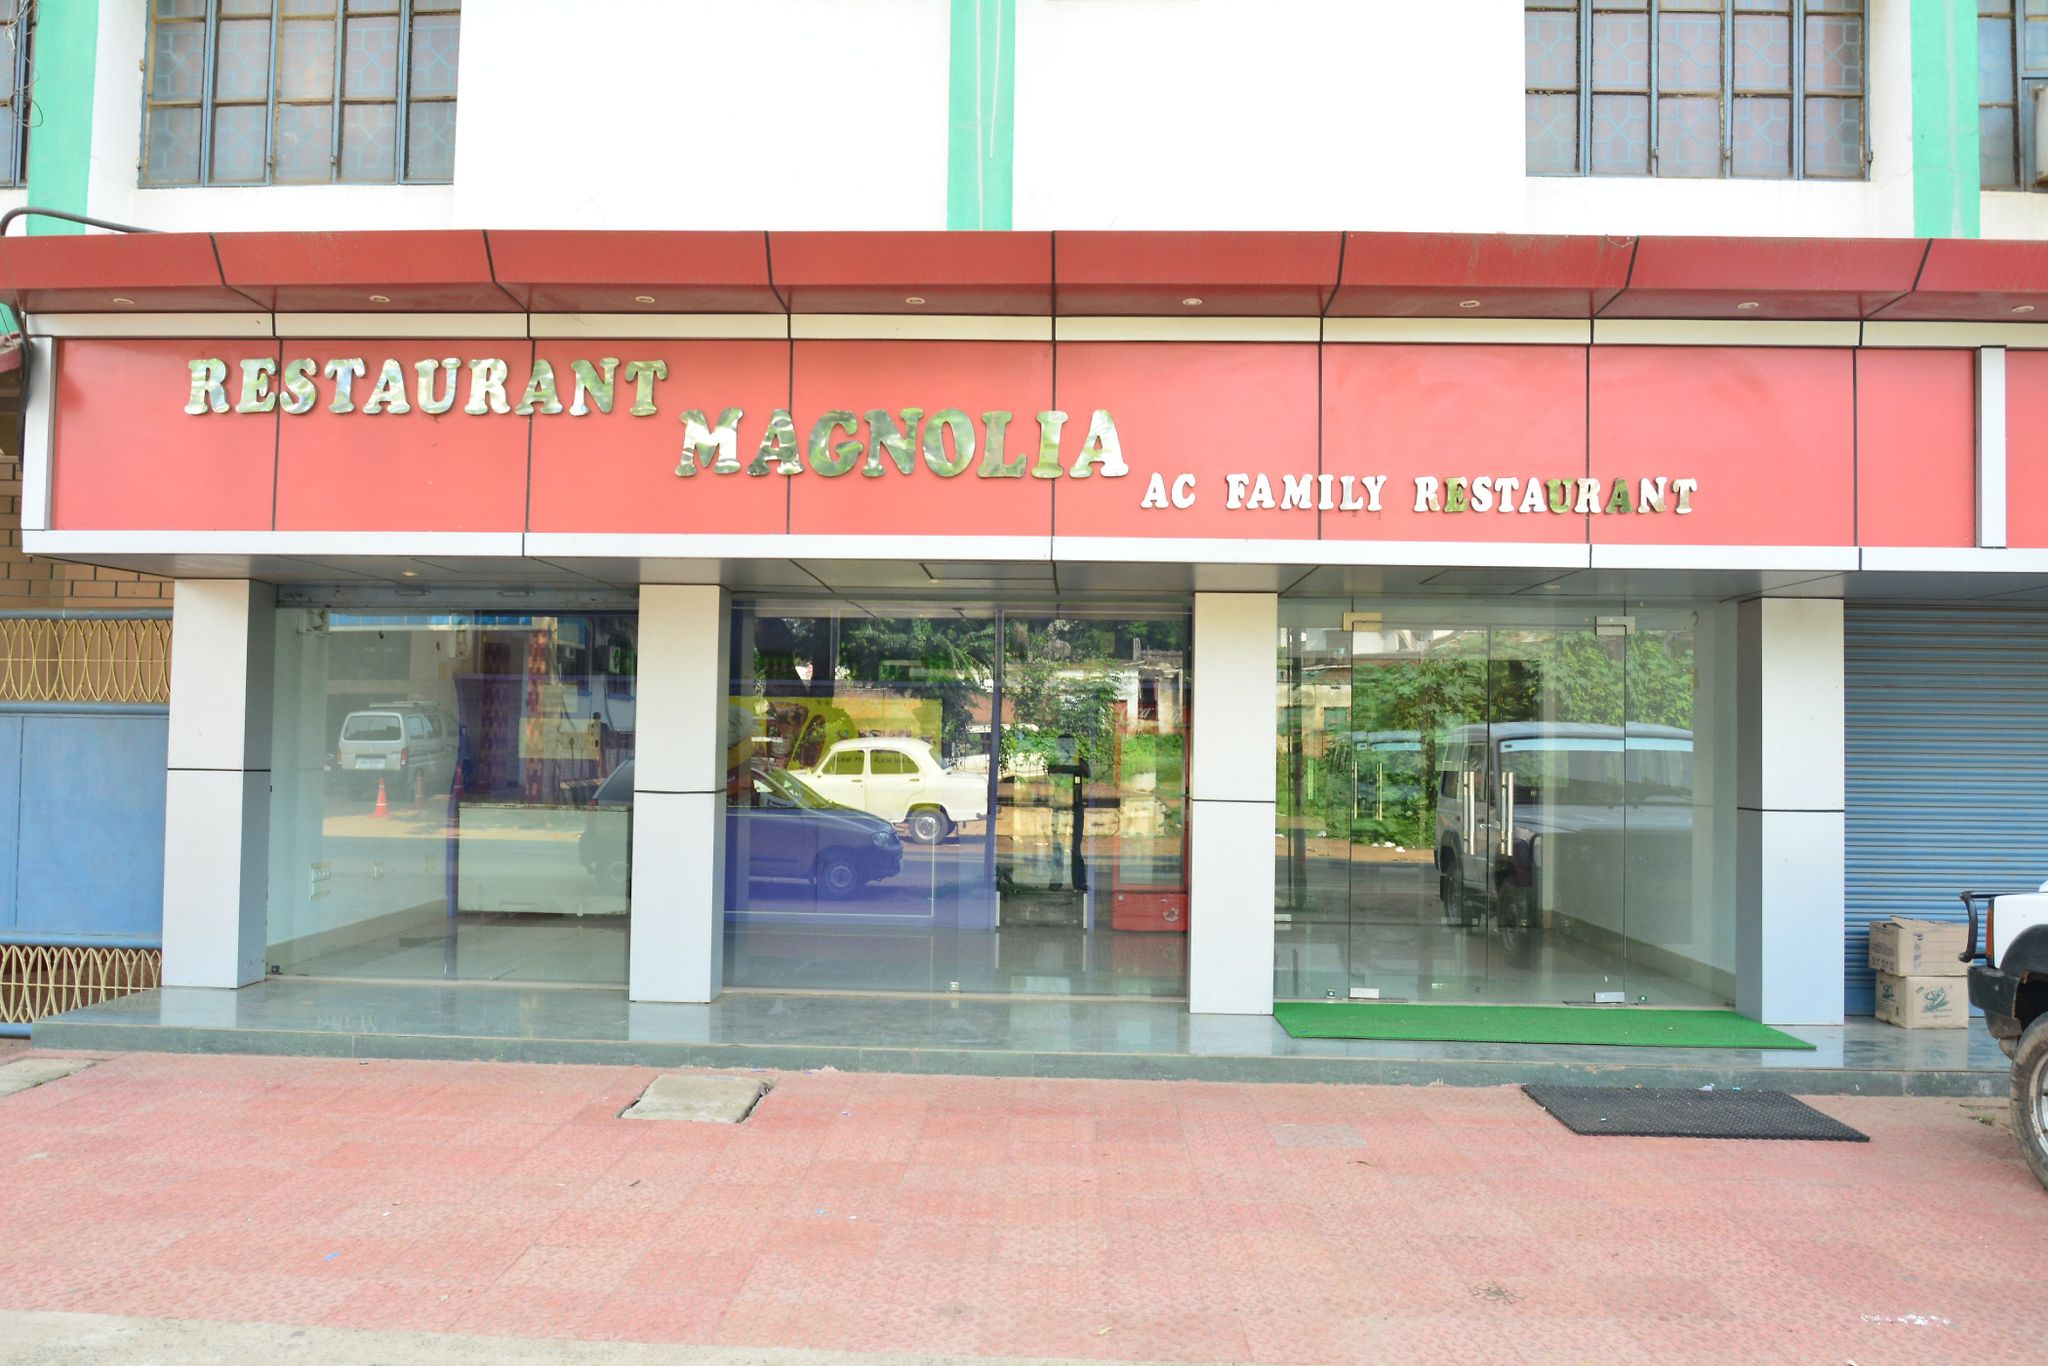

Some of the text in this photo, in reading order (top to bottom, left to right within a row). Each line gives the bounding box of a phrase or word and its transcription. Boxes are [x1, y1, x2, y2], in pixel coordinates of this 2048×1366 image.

[184, 357, 667, 416] RESTAURANT
[674, 407, 1129, 479] MAGNOLIA
[1140, 471, 1698, 514] AC FAMILY RESTAURANT
